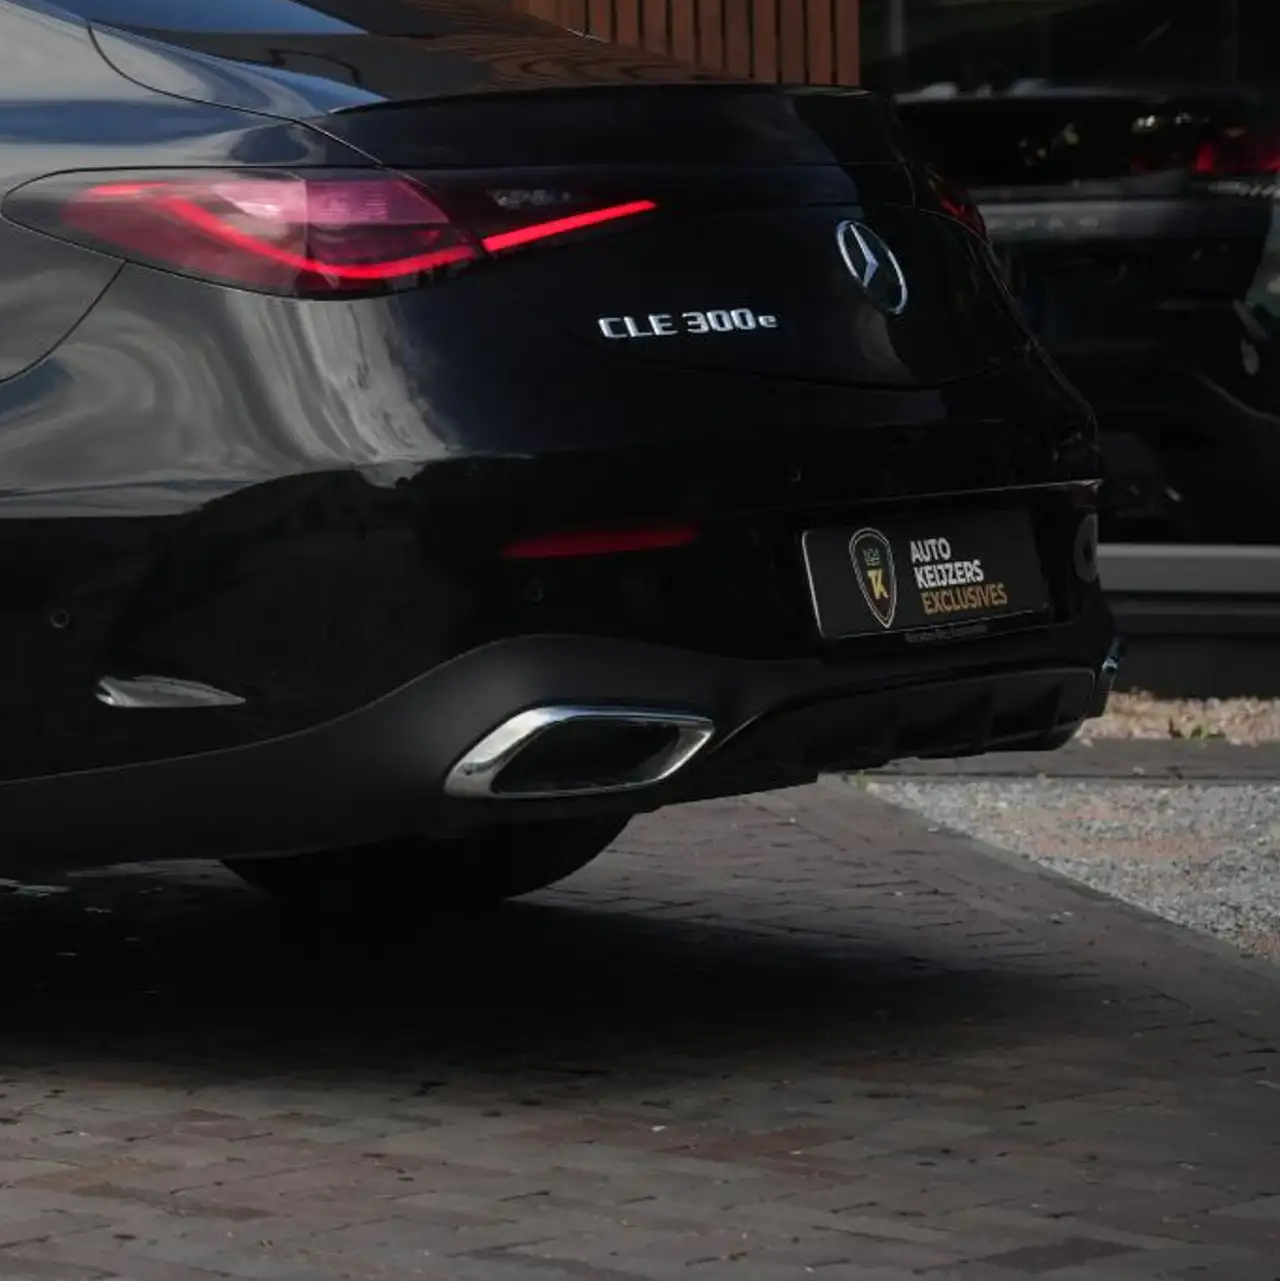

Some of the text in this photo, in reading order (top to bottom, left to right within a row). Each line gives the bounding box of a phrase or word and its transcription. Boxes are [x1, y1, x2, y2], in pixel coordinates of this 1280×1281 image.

[598, 307, 779, 339] CLE 300e
[910, 537, 951, 563] AUTO
[914, 559, 984, 589] KEIJZERS
[921, 583, 1008, 615] EXCLUSIVES
